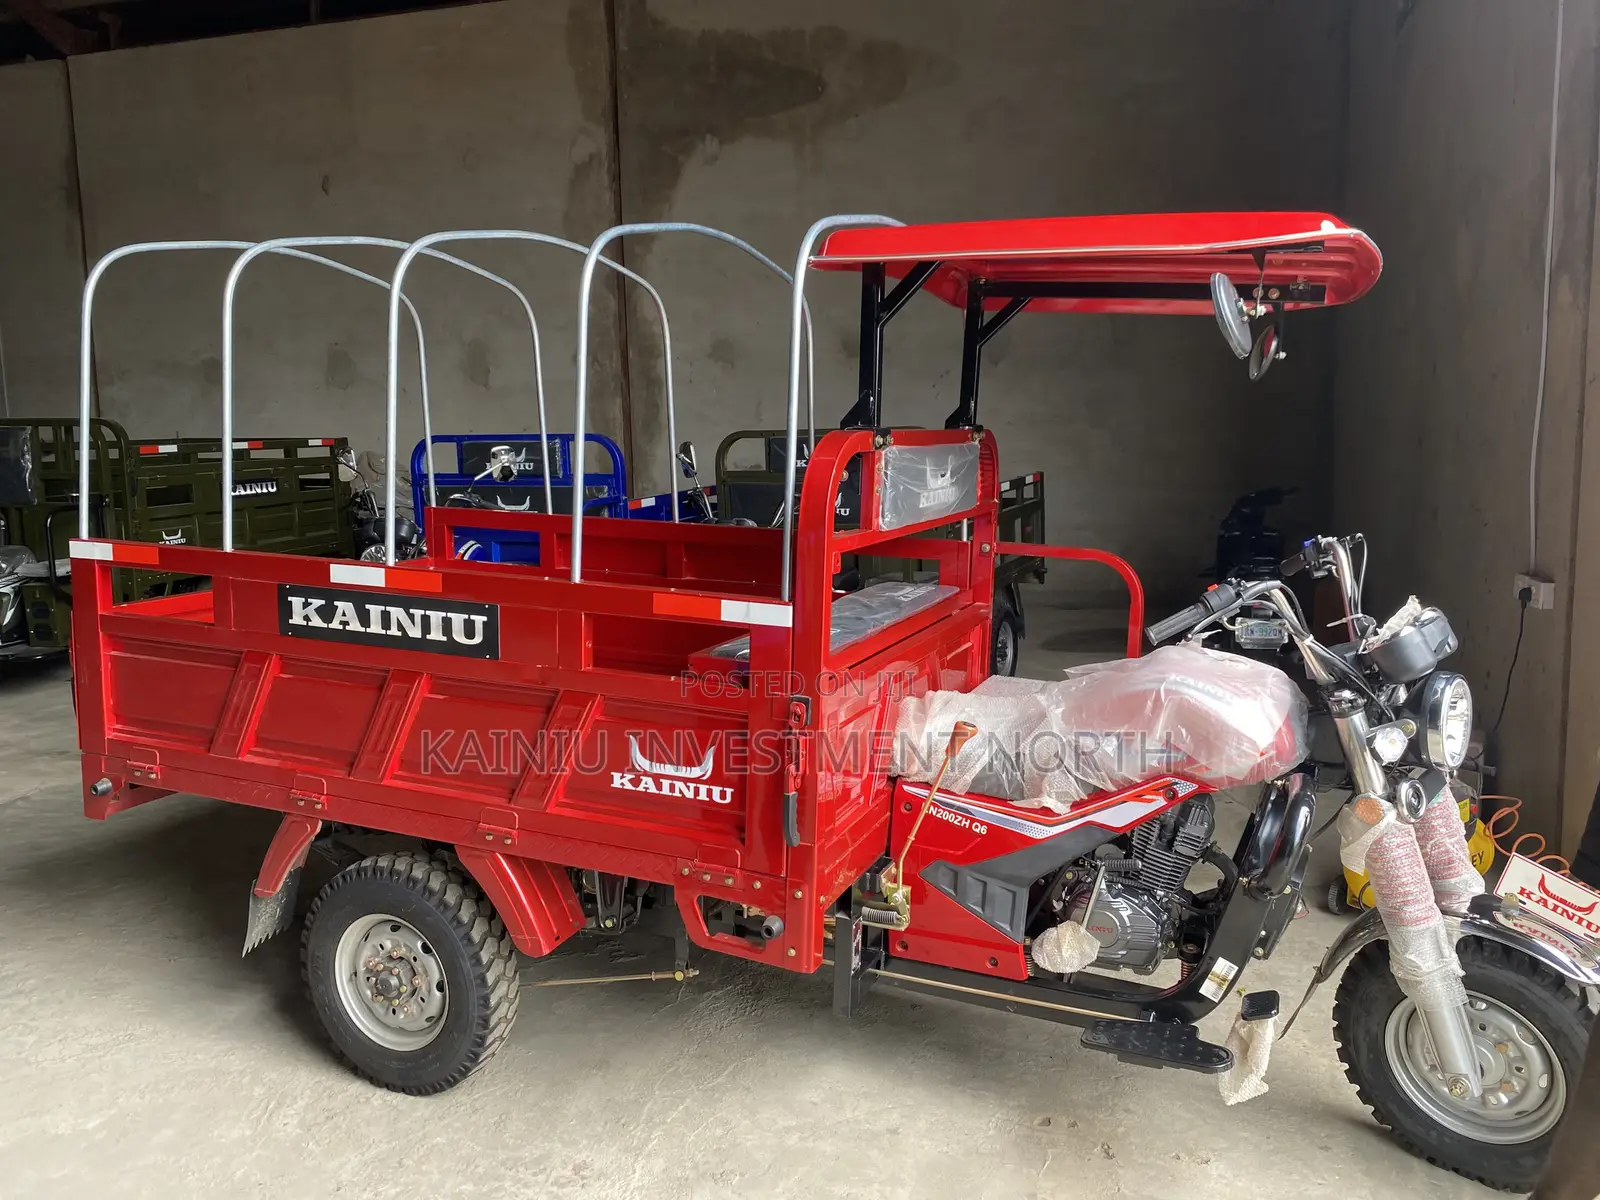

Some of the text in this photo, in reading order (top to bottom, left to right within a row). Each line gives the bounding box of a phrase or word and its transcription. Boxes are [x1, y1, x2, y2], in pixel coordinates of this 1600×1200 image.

[287, 596, 488, 645] KAINIU
[610, 771, 734, 804] KAINIU
[972, 821, 988, 835] Q6
[1516, 886, 1600, 934] KAINIU
